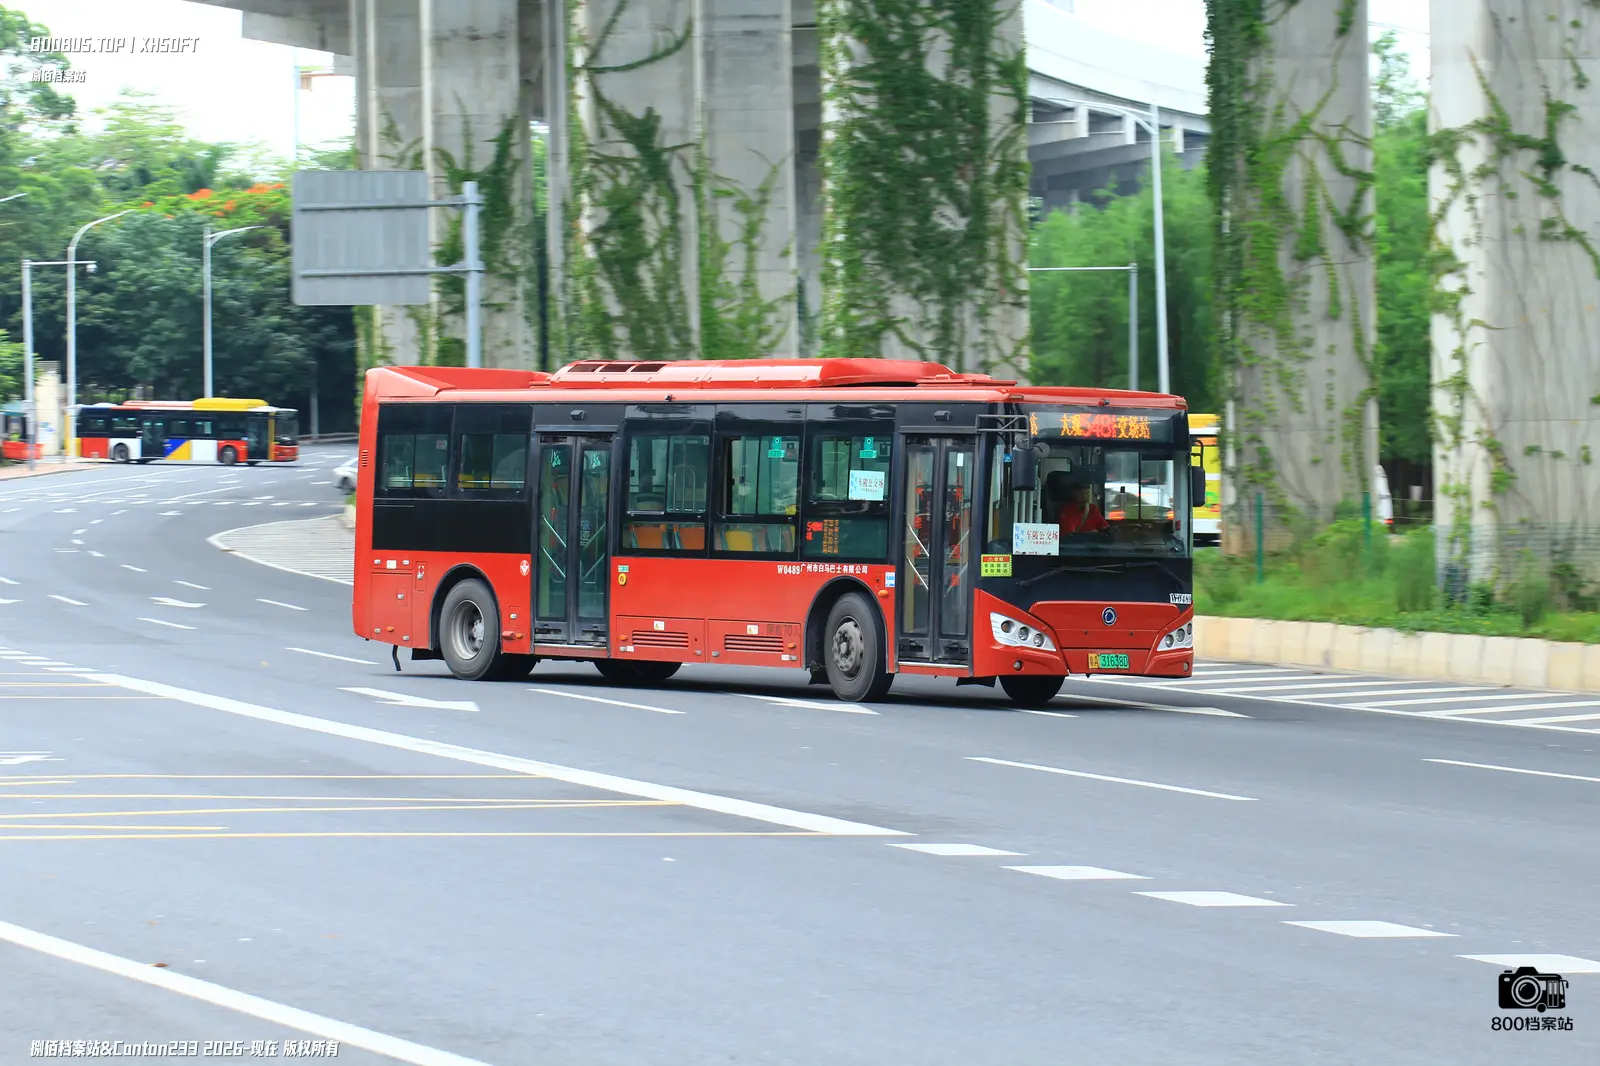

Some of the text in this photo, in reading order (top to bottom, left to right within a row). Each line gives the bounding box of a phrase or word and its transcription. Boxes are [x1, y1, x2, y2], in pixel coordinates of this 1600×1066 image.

[800, 563, 868, 575] 广州市白马巴士有限公司
